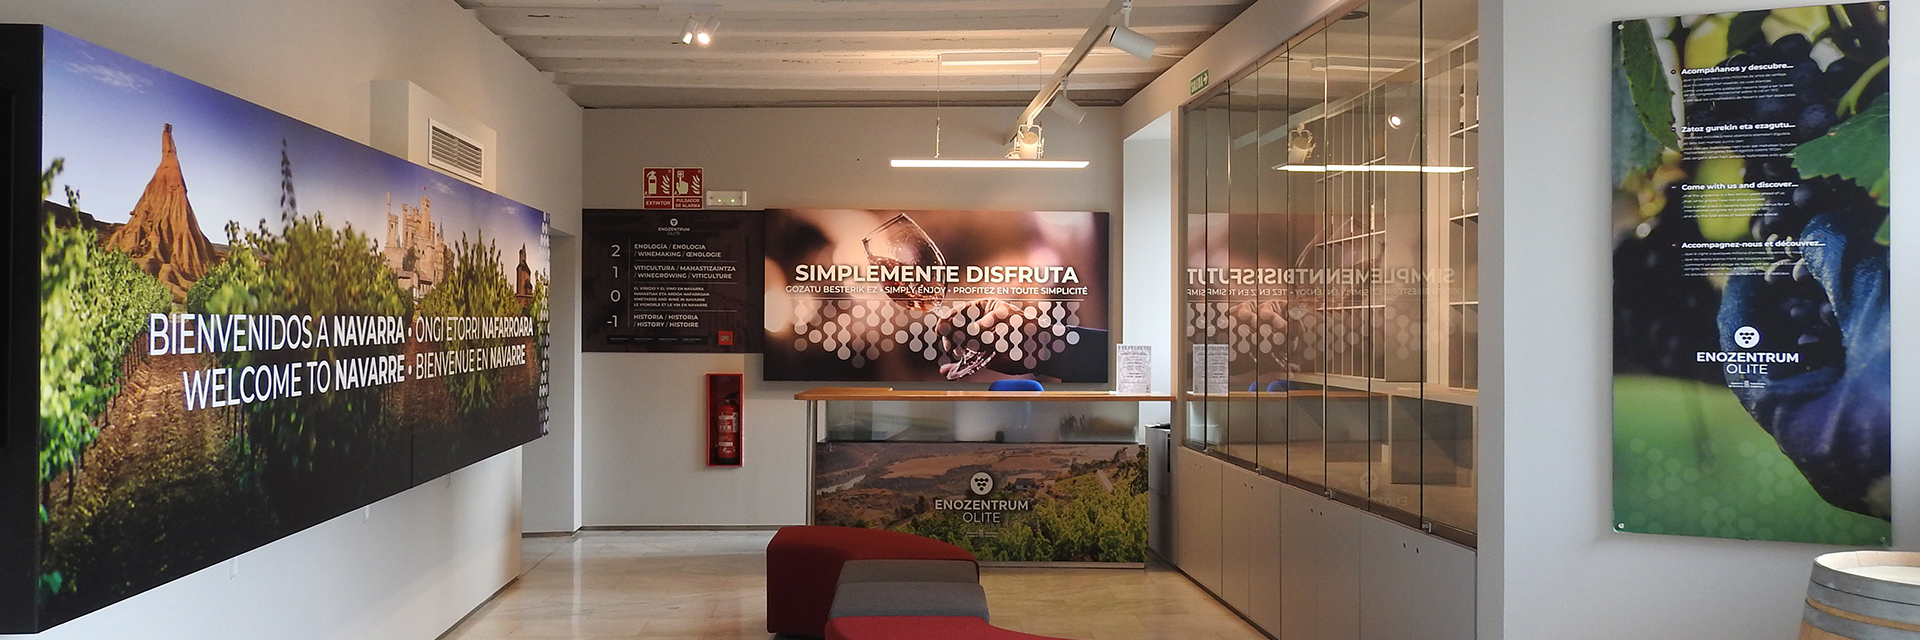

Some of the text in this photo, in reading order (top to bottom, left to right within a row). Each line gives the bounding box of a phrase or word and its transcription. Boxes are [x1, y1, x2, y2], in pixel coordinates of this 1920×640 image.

[1681, 65, 1740, 76] Acompáñanos
[1705, 124, 1738, 133] gurekin
[1681, 183, 1706, 191] Come
[1706, 182, 1726, 190] with
[611, 244, 621, 257] 2
[634, 242, 668, 250] ENOLOGÍA
[1681, 241, 1763, 250] Accompagnez-nous
[1764, 240, 1773, 248] et
[612, 266, 618, 278] 1
[795, 263, 1080, 284] SIMPLEMENTE DISFRUTA
[610, 289, 621, 303] 0
[785, 285, 821, 293] GOZATU
[823, 285, 864, 294] BESTERIK
[866, 286, 878, 294] EZ
[884, 286, 917, 294] SIMPLY
[953, 286, 996, 295] PROFITEZ
[997, 287, 1009, 295] EN
[1010, 287, 1039, 295] TOUTE
[1040, 285, 1088, 295] SIMPLICITÉ
[148, 312, 312, 356] BIENVENIDOS
[316, 315, 330, 348] A
[333, 315, 405, 348] NAVARRA
[415, 316, 445, 343] ONGI
[446, 316, 480, 342] ETORRI
[482, 316, 534, 340] NAFARROARA
[1696, 351, 1799, 363] ENOZENTRUM
[1726, 363, 1769, 375] OLITE
[183, 364, 302, 411] WELCOME
[306, 361, 331, 394] TO
[335, 354, 405, 391] NAVARRE
[415, 350, 475, 380] BIENVENUE
[476, 348, 489, 371] EN
[490, 344, 526, 369] NAVARRE
[935, 499, 1029, 511] ENOZENTRUM
[962, 511, 1001, 523] OLITE
